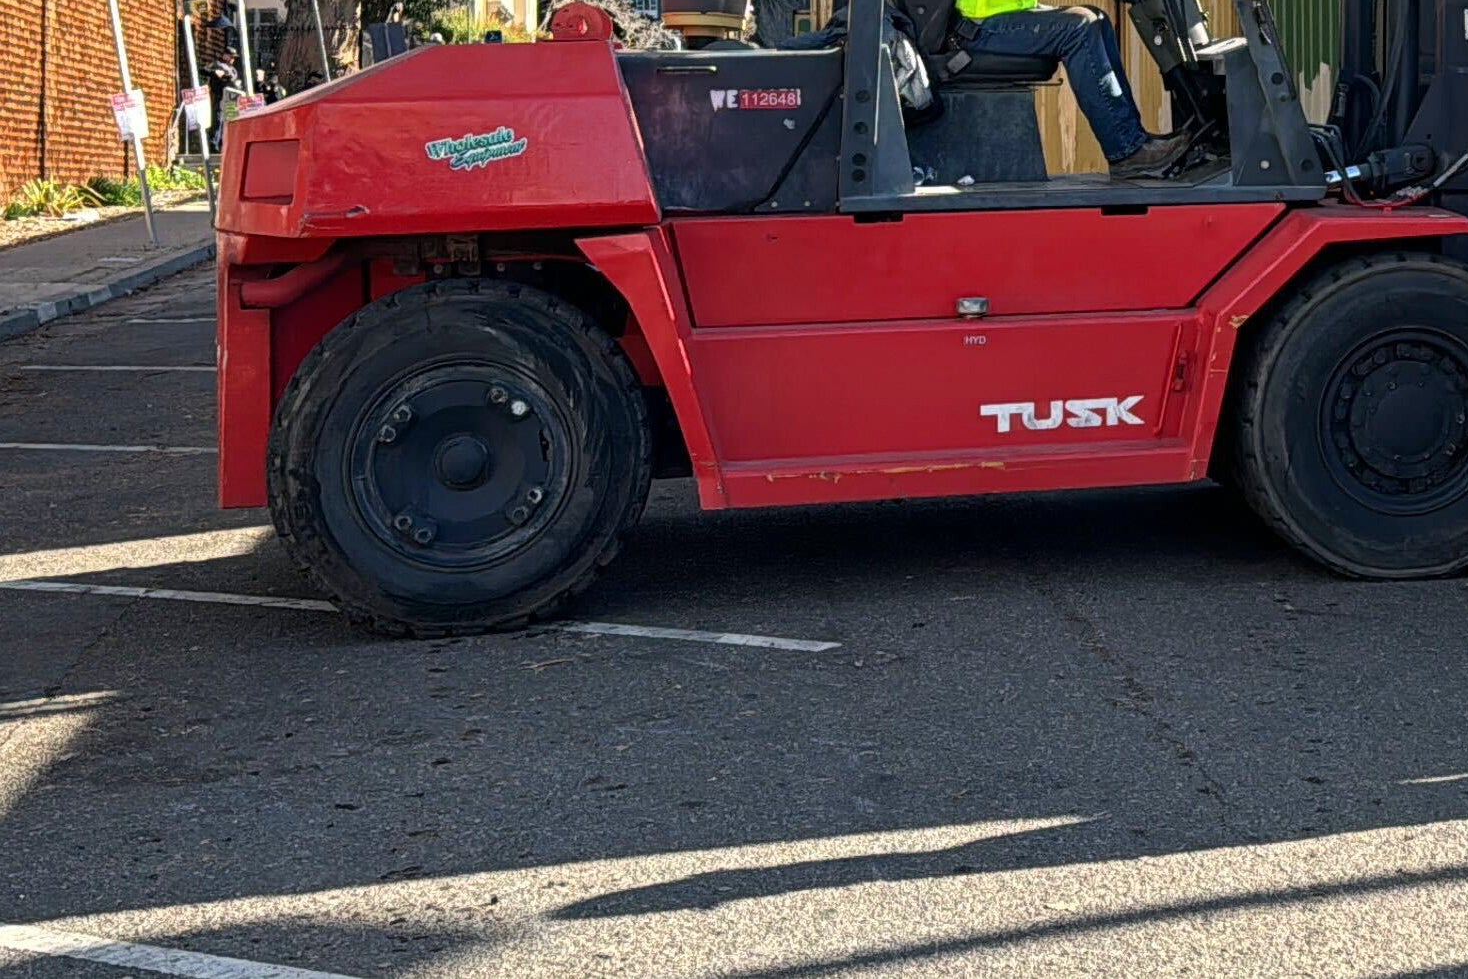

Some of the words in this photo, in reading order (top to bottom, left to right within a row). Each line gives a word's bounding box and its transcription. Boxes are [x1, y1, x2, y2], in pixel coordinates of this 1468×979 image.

[741, 91, 796, 107] 112648
[965, 335, 987, 345] HYD
[980, 395, 1145, 433] TUSK
